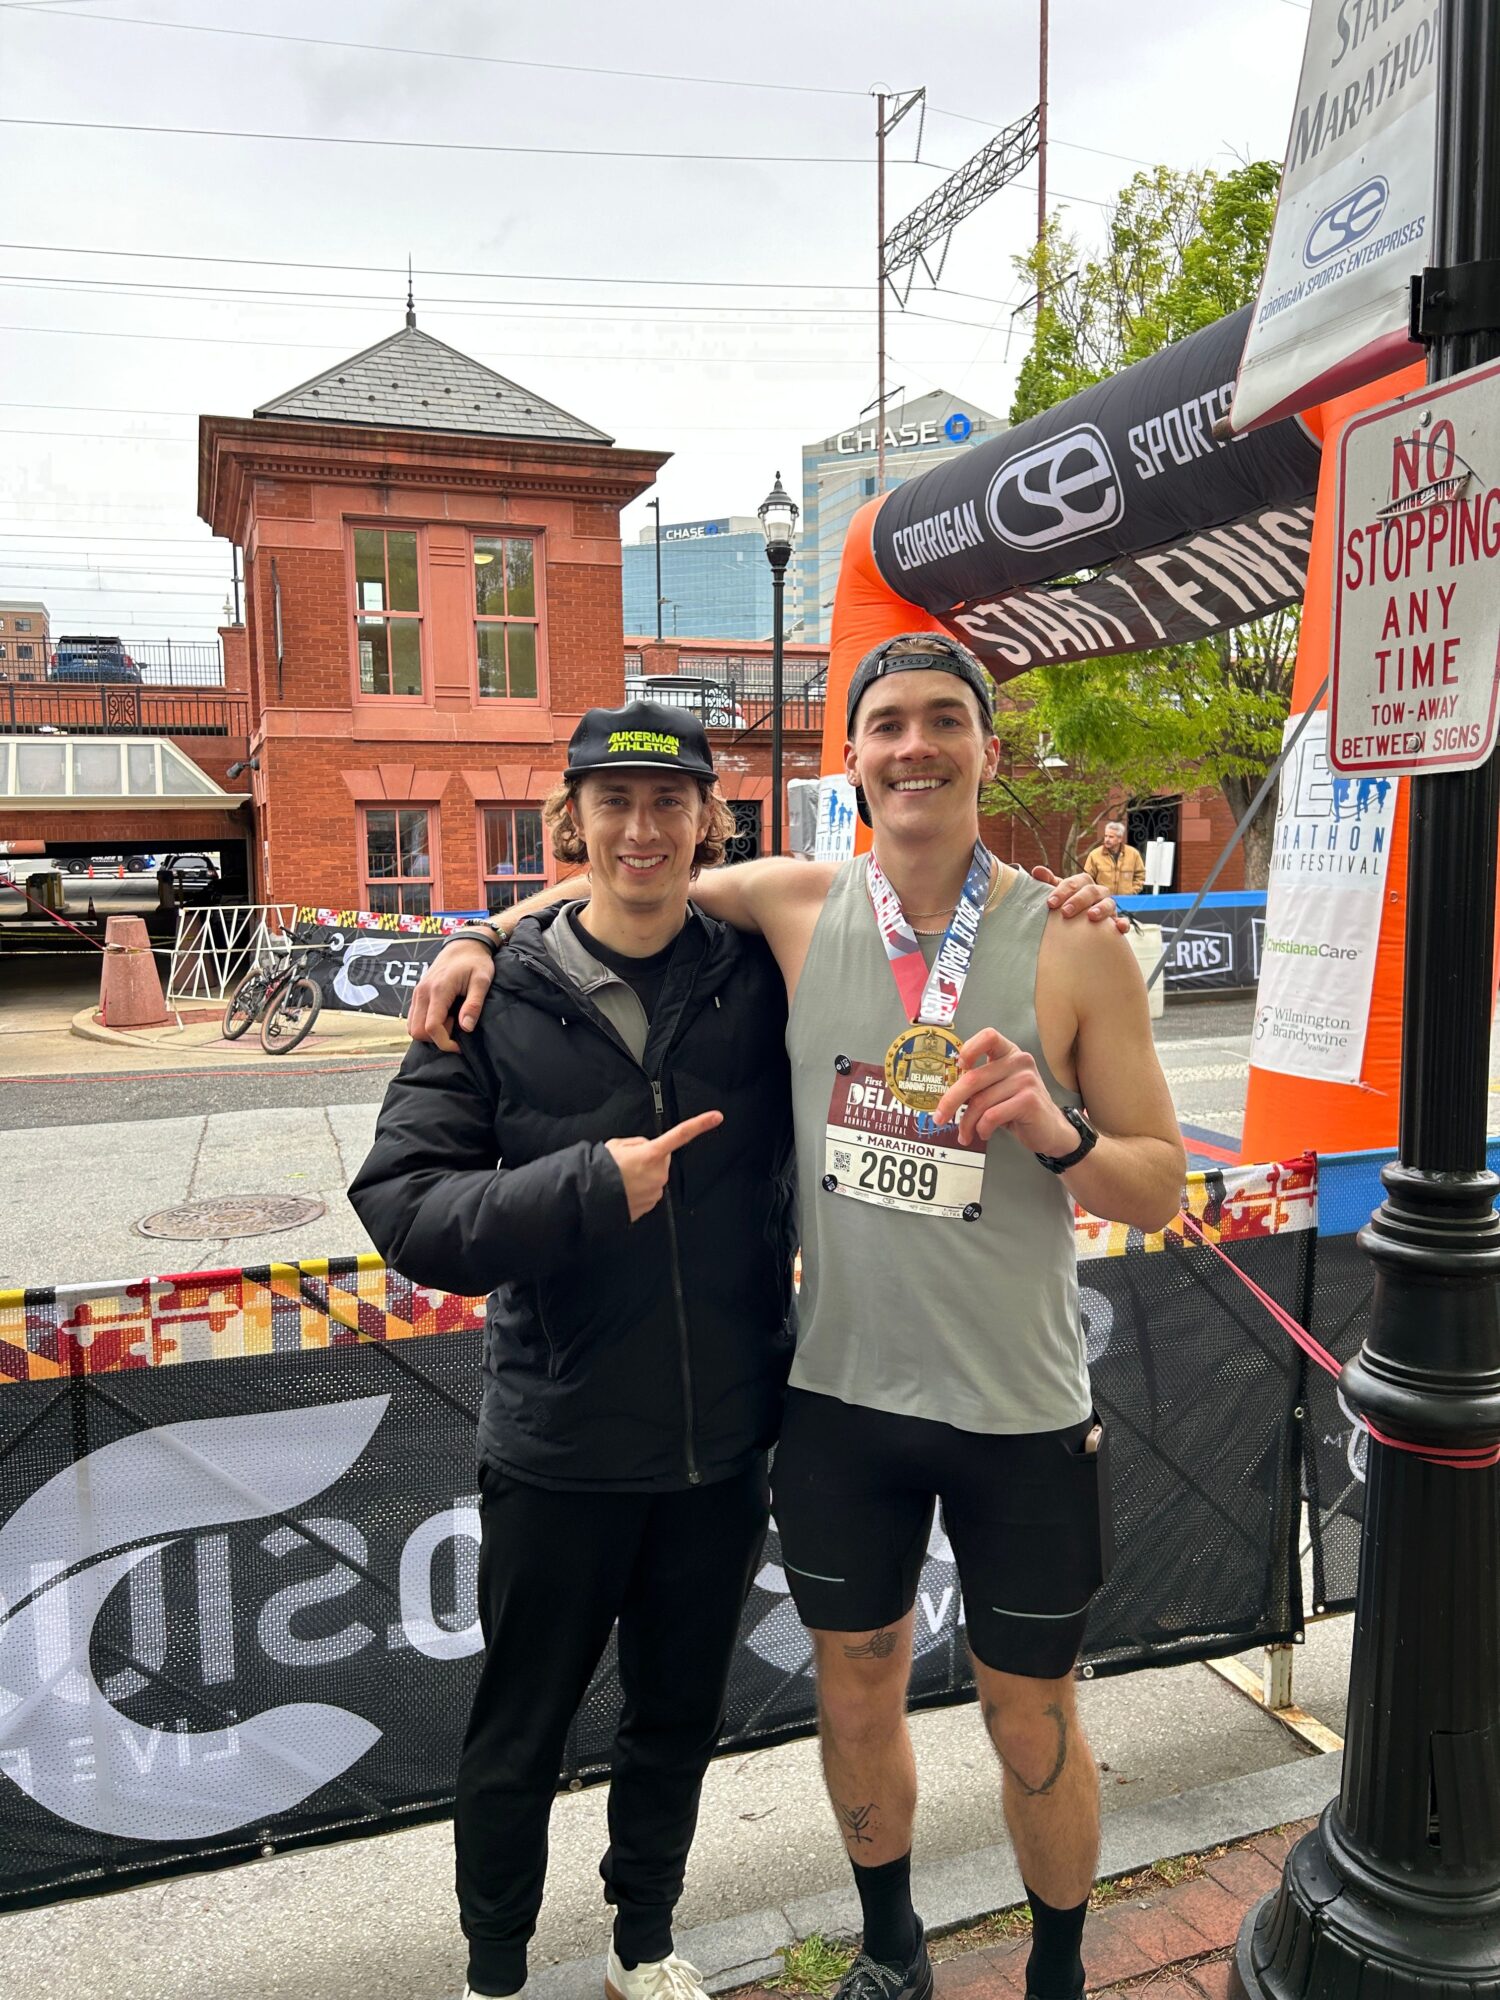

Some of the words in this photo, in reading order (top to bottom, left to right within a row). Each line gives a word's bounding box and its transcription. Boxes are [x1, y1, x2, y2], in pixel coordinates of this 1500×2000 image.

[1331, 0, 1403, 68] STA
[1258, 281, 1308, 324] CORRIGAN
[1304, 259, 1347, 297] SPORTS
[1345, 216, 1425, 274] ENTERPRISES
[837, 420, 940, 455] CHASE
[1392, 419, 1455, 500] NO
[666, 527, 705, 540] CHASE
[893, 499, 985, 571] CORRIGAN
[1345, 486, 1500, 592] STOPPING
[954, 588, 1135, 666] START
[1135, 506, 1316, 627] FINIS
[1381, 582, 1457, 641] ANY
[1375, 637, 1461, 694] TIME
[1372, 694, 1460, 726] TOW-AWAY
[608, 731, 679, 748] AUKERMAN
[608, 742, 678, 756] ATHLETICS
[1341, 731, 1426, 760] BETWEEN
[1433, 723, 1481, 752] SIGNS
[1276, 825, 1385, 853] RATHON
[1301, 854, 1379, 875] FESTIVAL
[1163, 936, 1222, 969] RR'S
[1267, 938, 1358, 961] ChristianaCare
[1275, 1007, 1350, 1030] Wilmington
[1272, 1024, 1348, 1047] Brandywine
[1307, 1043, 1330, 1054] Valley
[865, 1075, 886, 1088] First
[911, 1073, 943, 1084] DELAWARE
[926, 1084, 947, 1094] FESTIV
[843, 1115, 871, 1129] RUNNING
[874, 1122, 907, 1136] FESTIVAL
[844, 1104, 909, 1127] MARATHON
[867, 1135, 935, 1157] MARATHON
[859, 1151, 938, 1201] 2689
